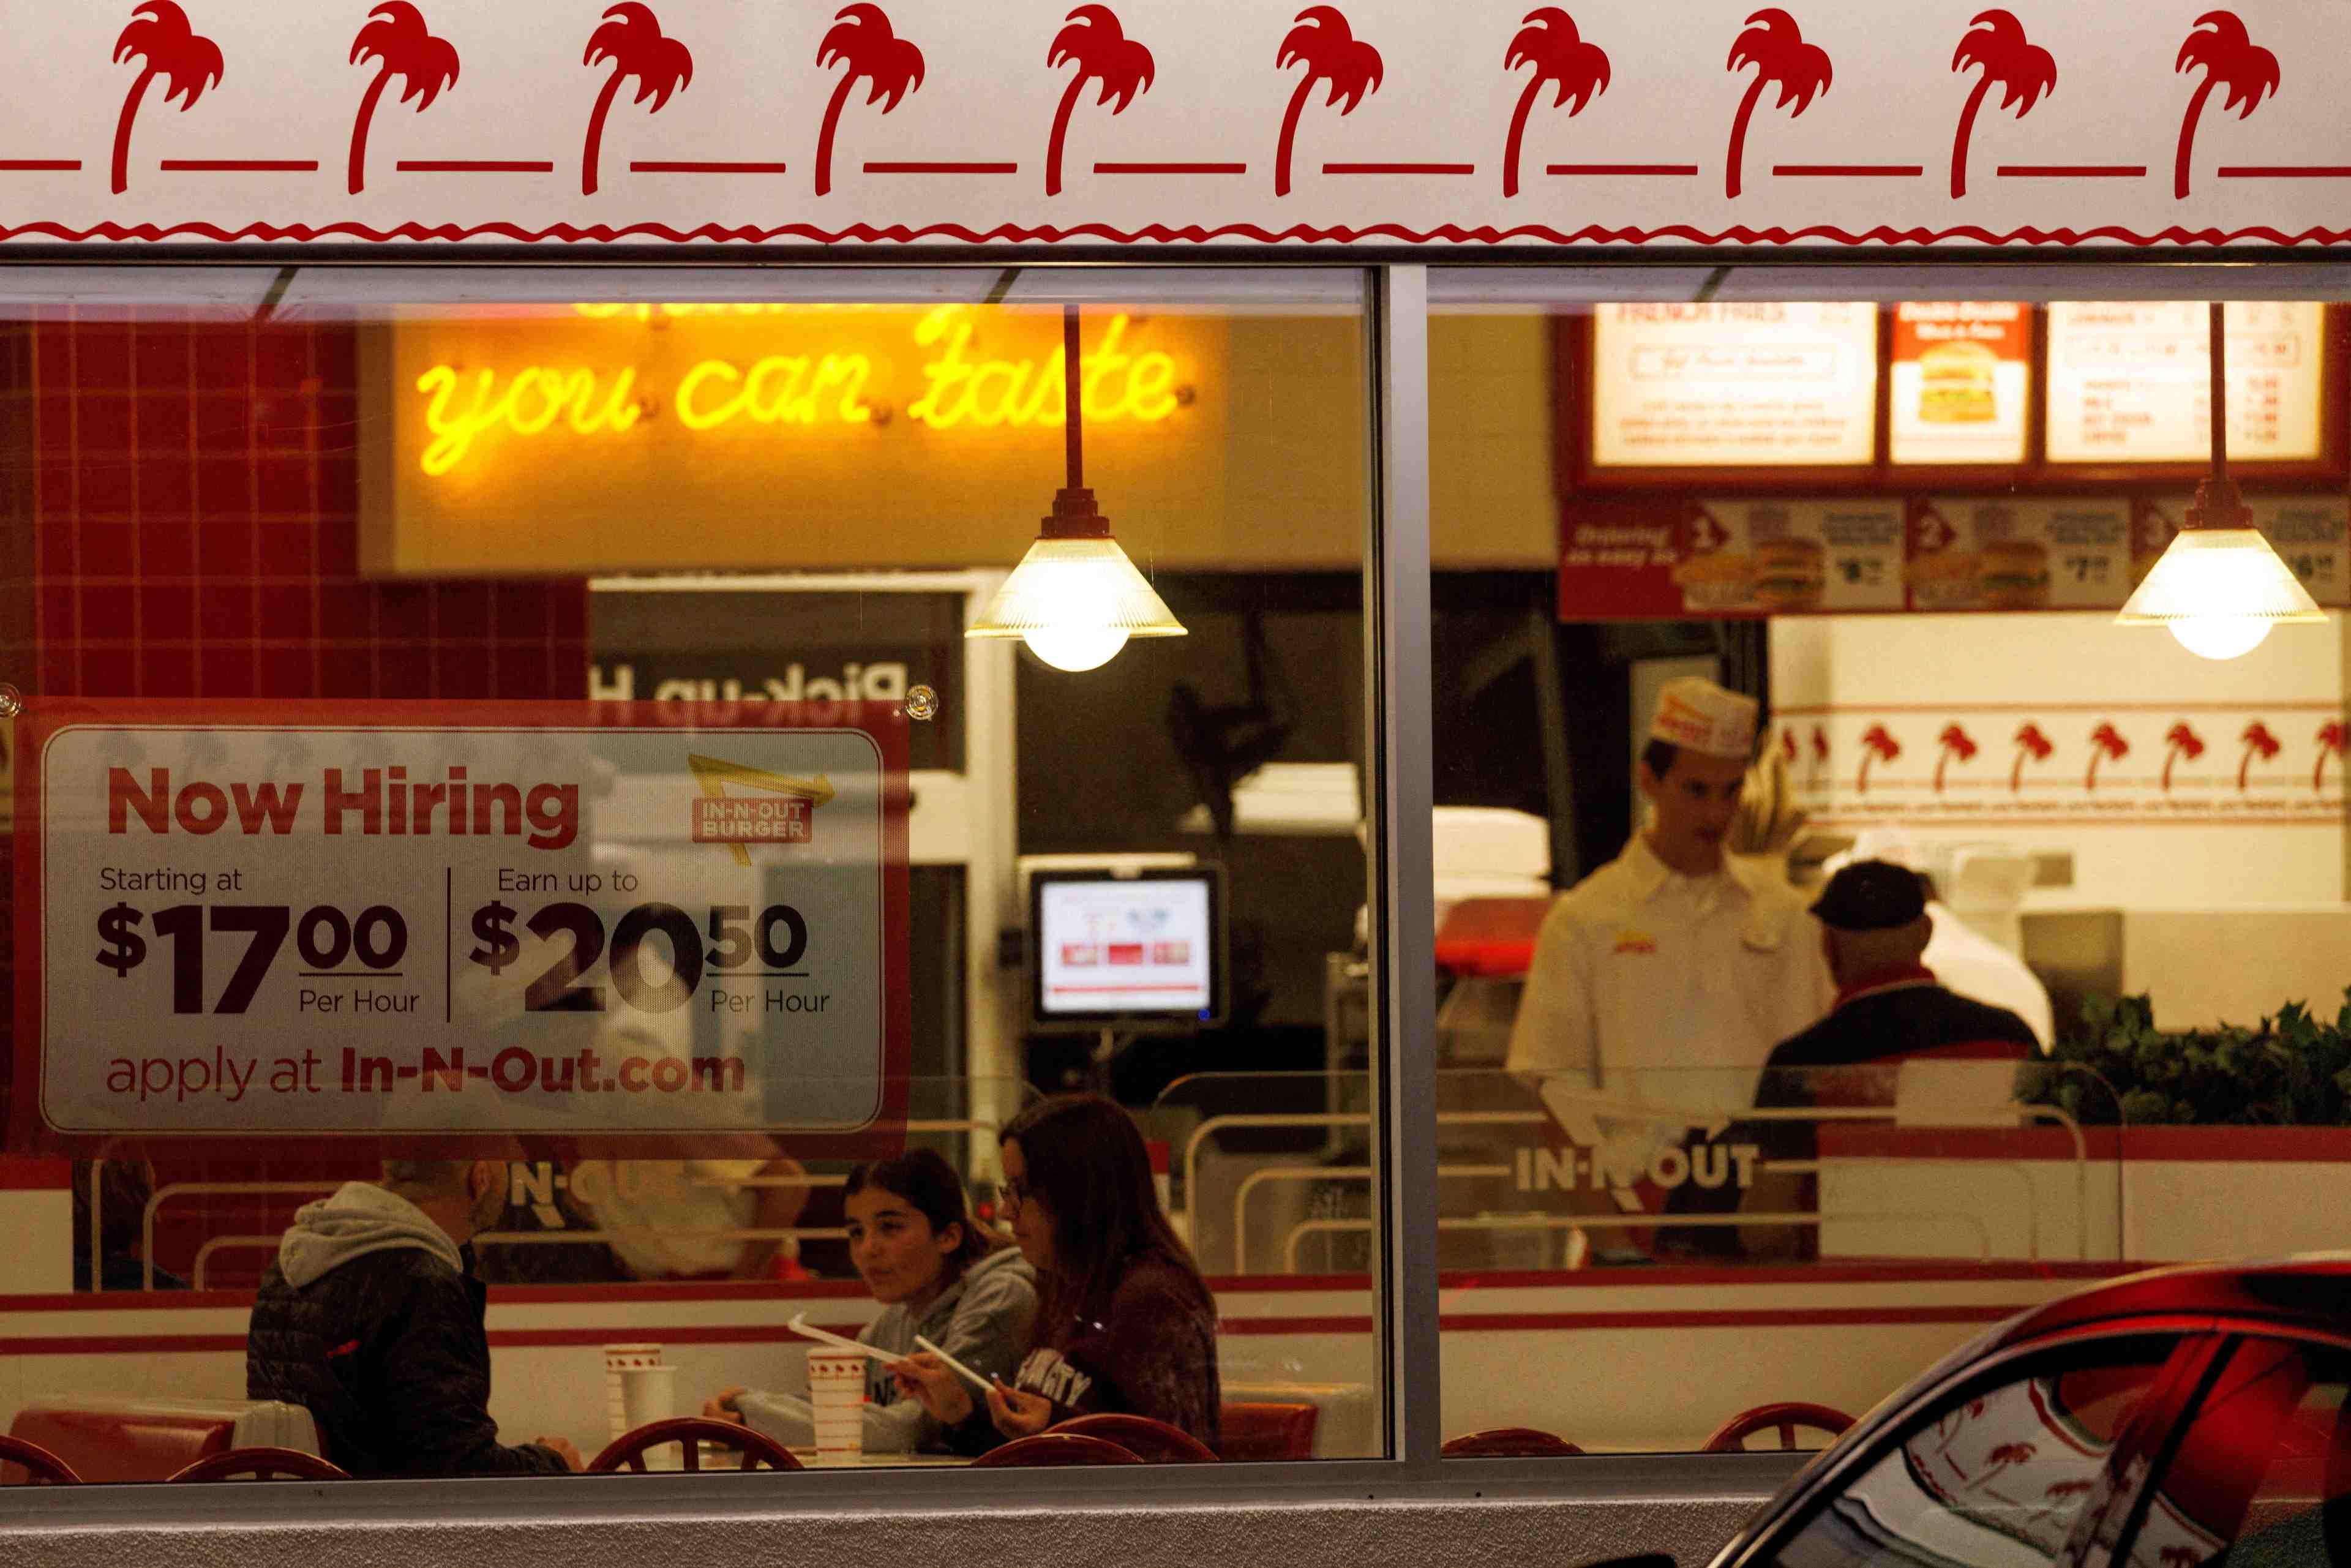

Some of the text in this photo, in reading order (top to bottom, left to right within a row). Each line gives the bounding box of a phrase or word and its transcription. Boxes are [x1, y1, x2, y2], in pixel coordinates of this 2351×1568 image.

[417, 312, 1178, 475] you can taste
[108, 765, 579, 850] Now Hiring
[703, 803, 804, 819] IN-N-OUT
[702, 821, 804, 838] BURGER
[100, 867, 242, 896] Starting at
[498, 870, 638, 897] Earn up to
[299, 990, 420, 1013] Per Hour
[711, 990, 830, 1013] Per Hour
[106, 1045, 745, 1102] apply at In-N-Out.com
